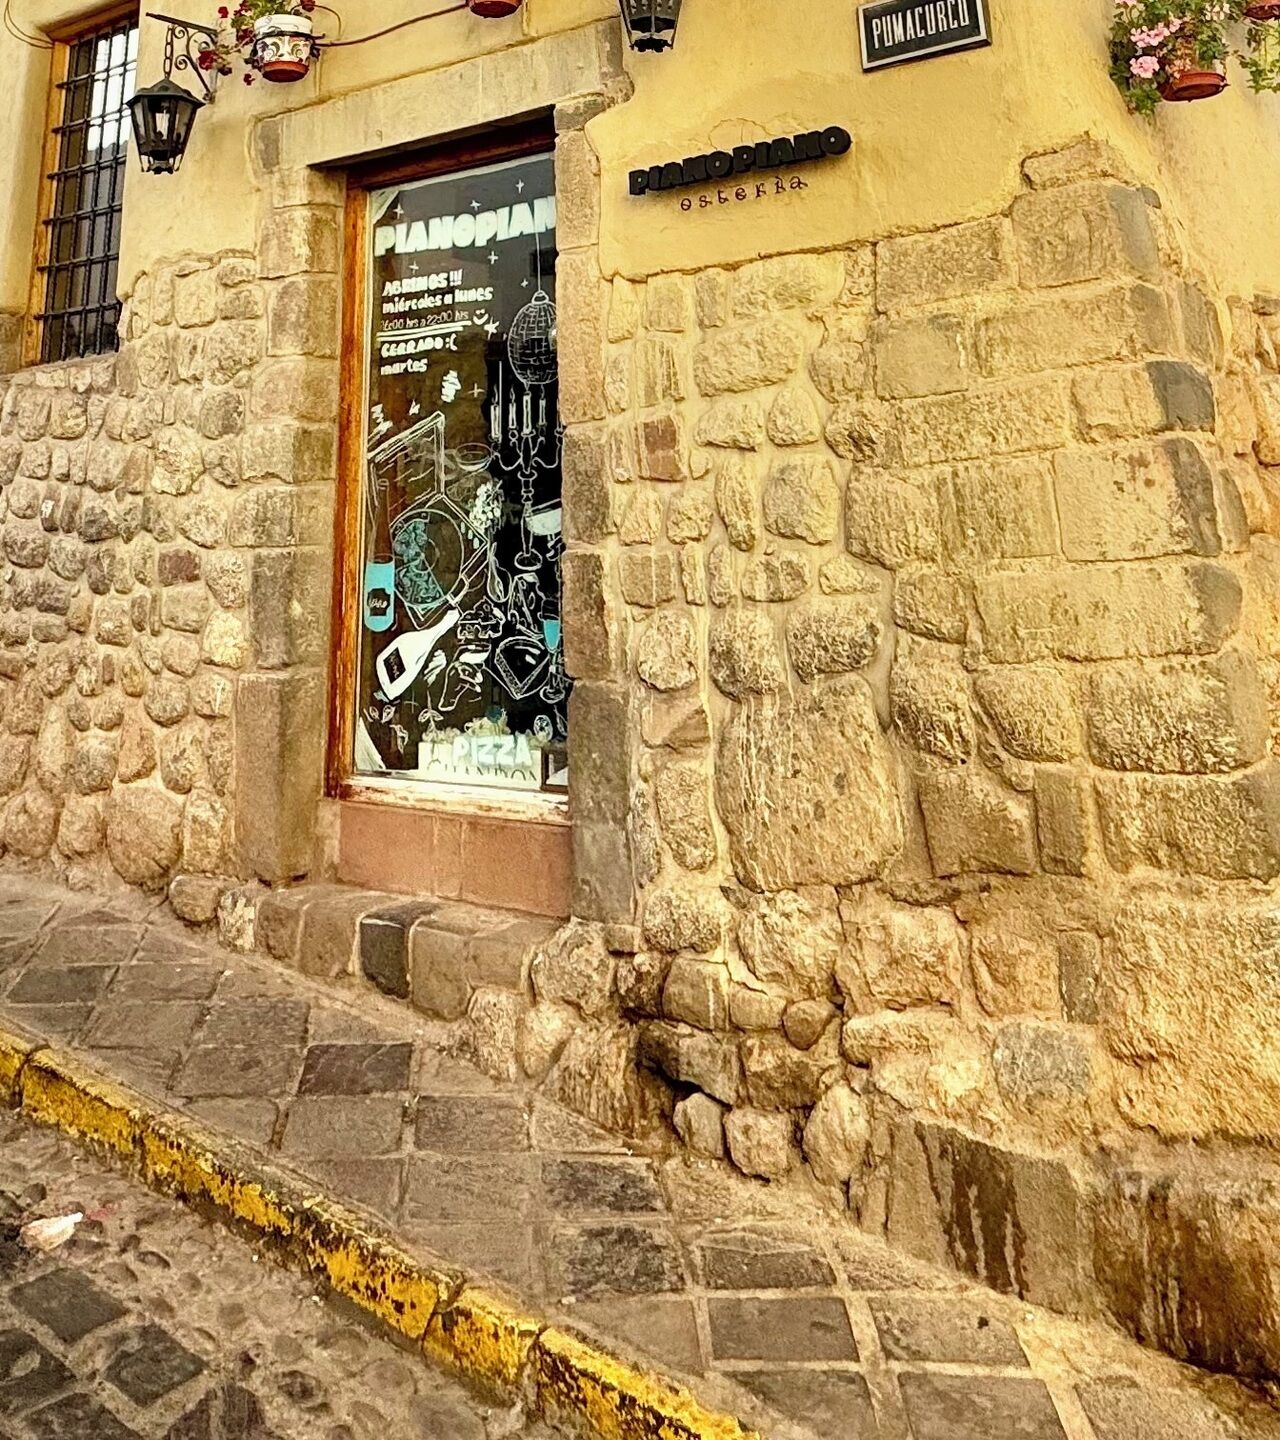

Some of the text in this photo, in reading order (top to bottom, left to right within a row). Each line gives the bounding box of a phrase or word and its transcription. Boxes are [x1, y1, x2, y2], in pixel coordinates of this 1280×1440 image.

[628, 125, 852, 196] PIANOPIANO
[680, 175, 808, 212] osteria
[382, 272, 448, 297] ABRIMOS
[382, 293, 442, 314] miércoles
[454, 287, 494, 303] lunes
[381, 337, 444, 358] CERRADO
[380, 359, 428, 375] martes
[452, 734, 533, 767] PIZZA
